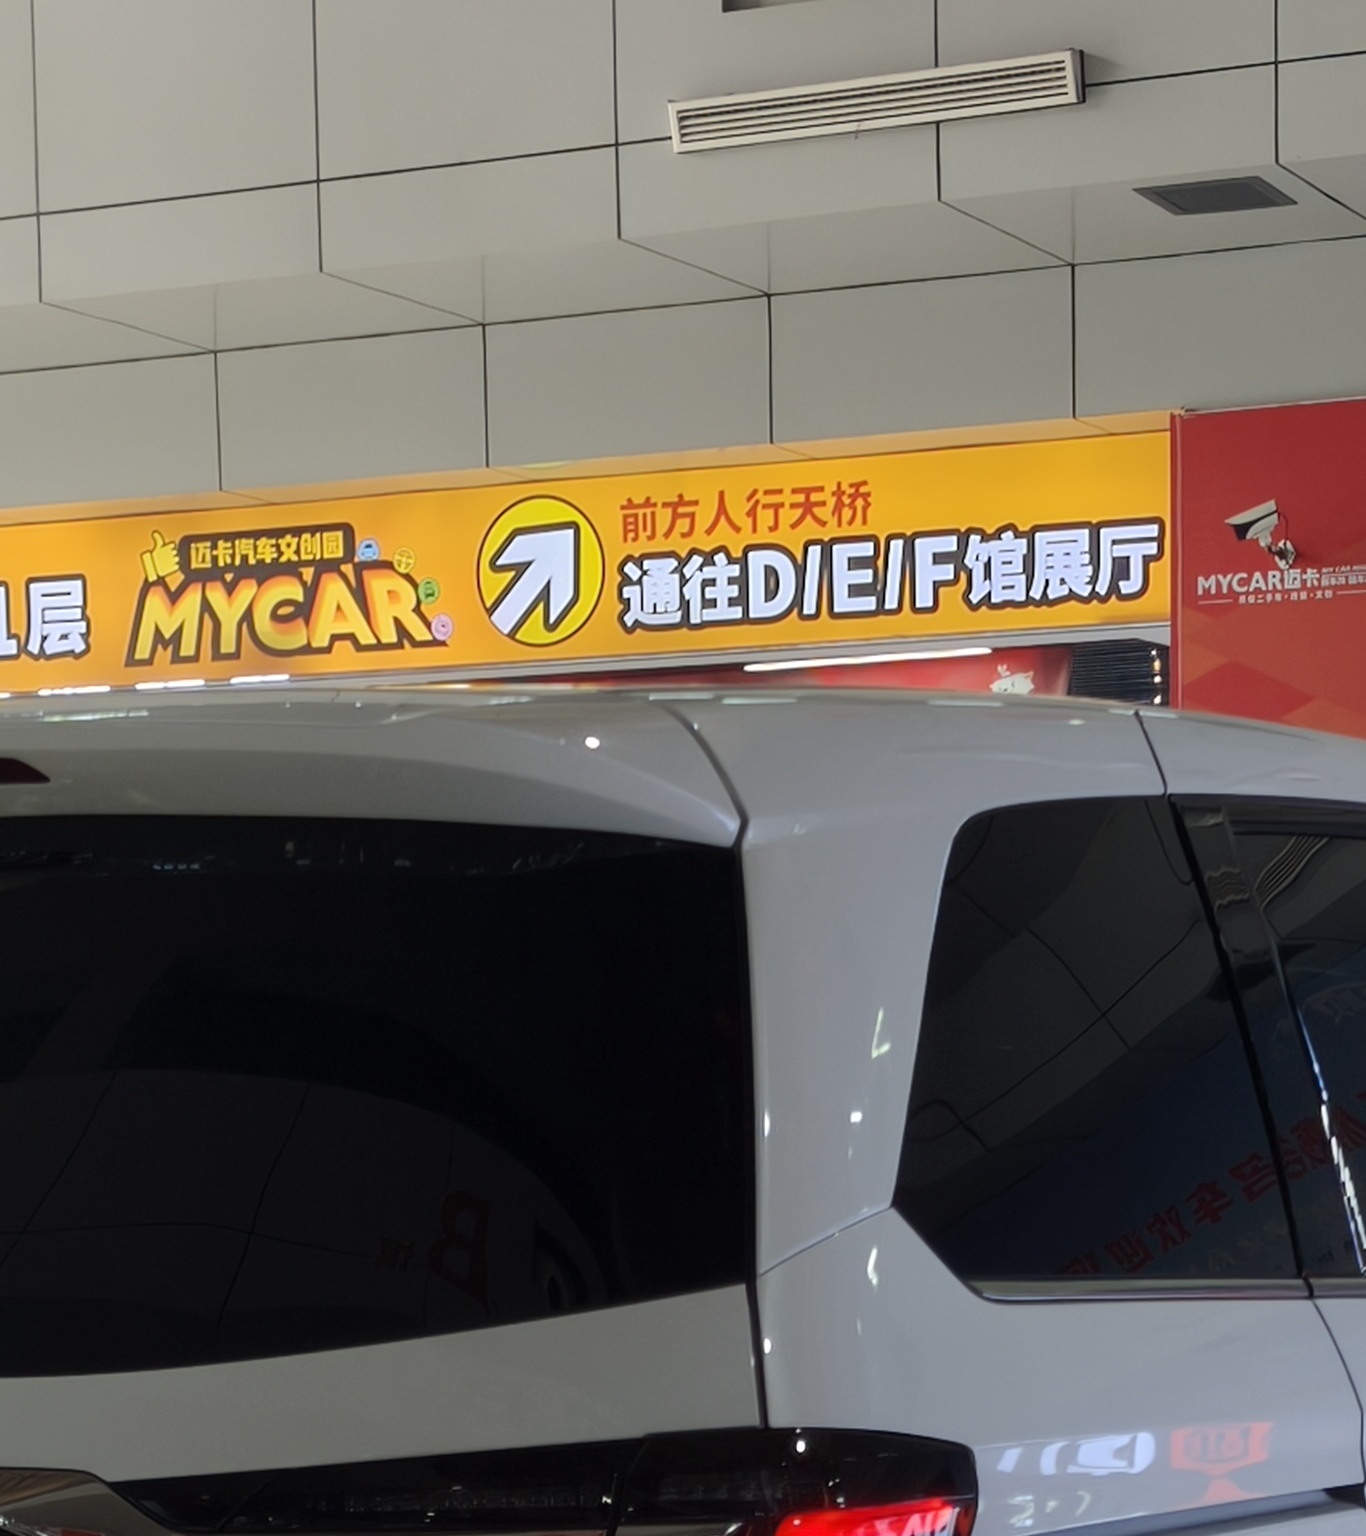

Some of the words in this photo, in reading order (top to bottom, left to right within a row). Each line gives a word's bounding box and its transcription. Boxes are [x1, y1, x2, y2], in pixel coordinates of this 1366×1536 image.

[619, 480, 871, 542] 前方人行天桥
[189, 530, 344, 569] 迈卡汽车文创园
[621, 523, 1160, 628] 通往D/E/F馆展厅
[1196, 567, 1320, 596] MYCAR迈卡
[133, 566, 435, 662] MYCAR
